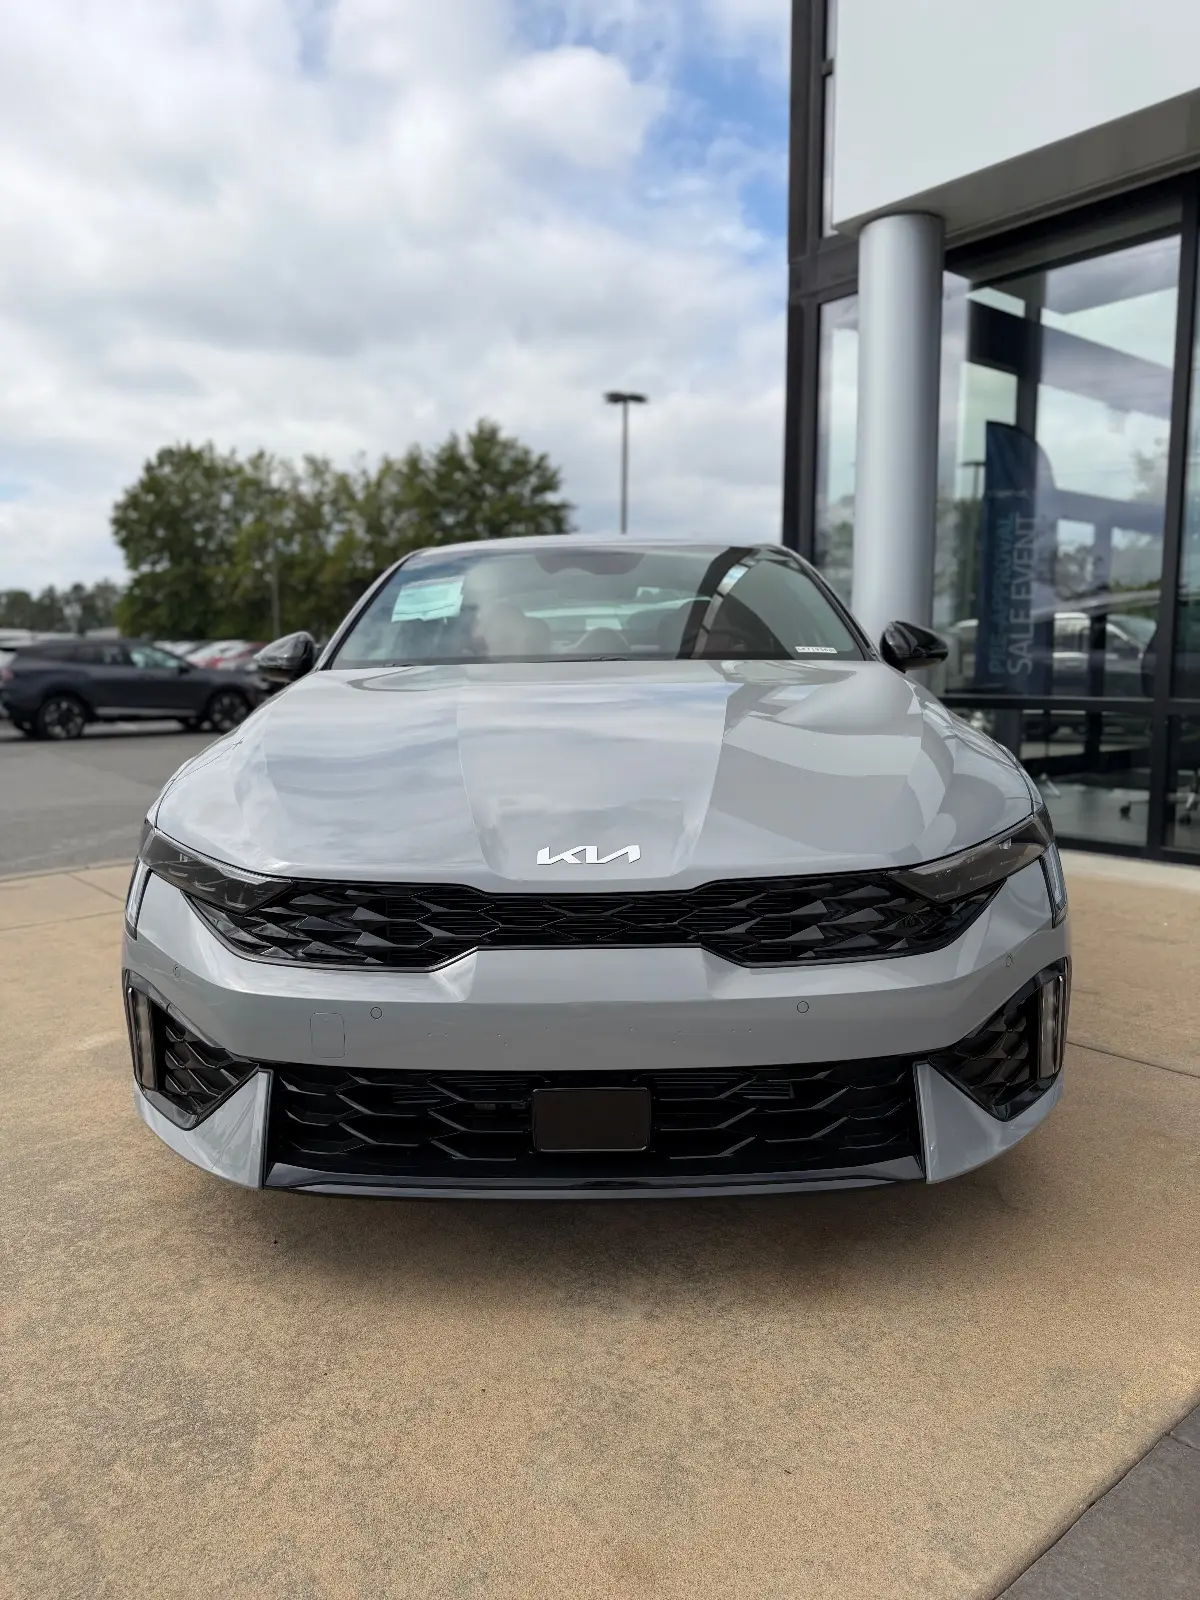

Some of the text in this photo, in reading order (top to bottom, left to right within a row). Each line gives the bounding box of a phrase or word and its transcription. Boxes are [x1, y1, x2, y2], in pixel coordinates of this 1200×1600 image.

[1007, 511, 1037, 675] SALE EVENT
[536, 844, 641, 866] KIA
